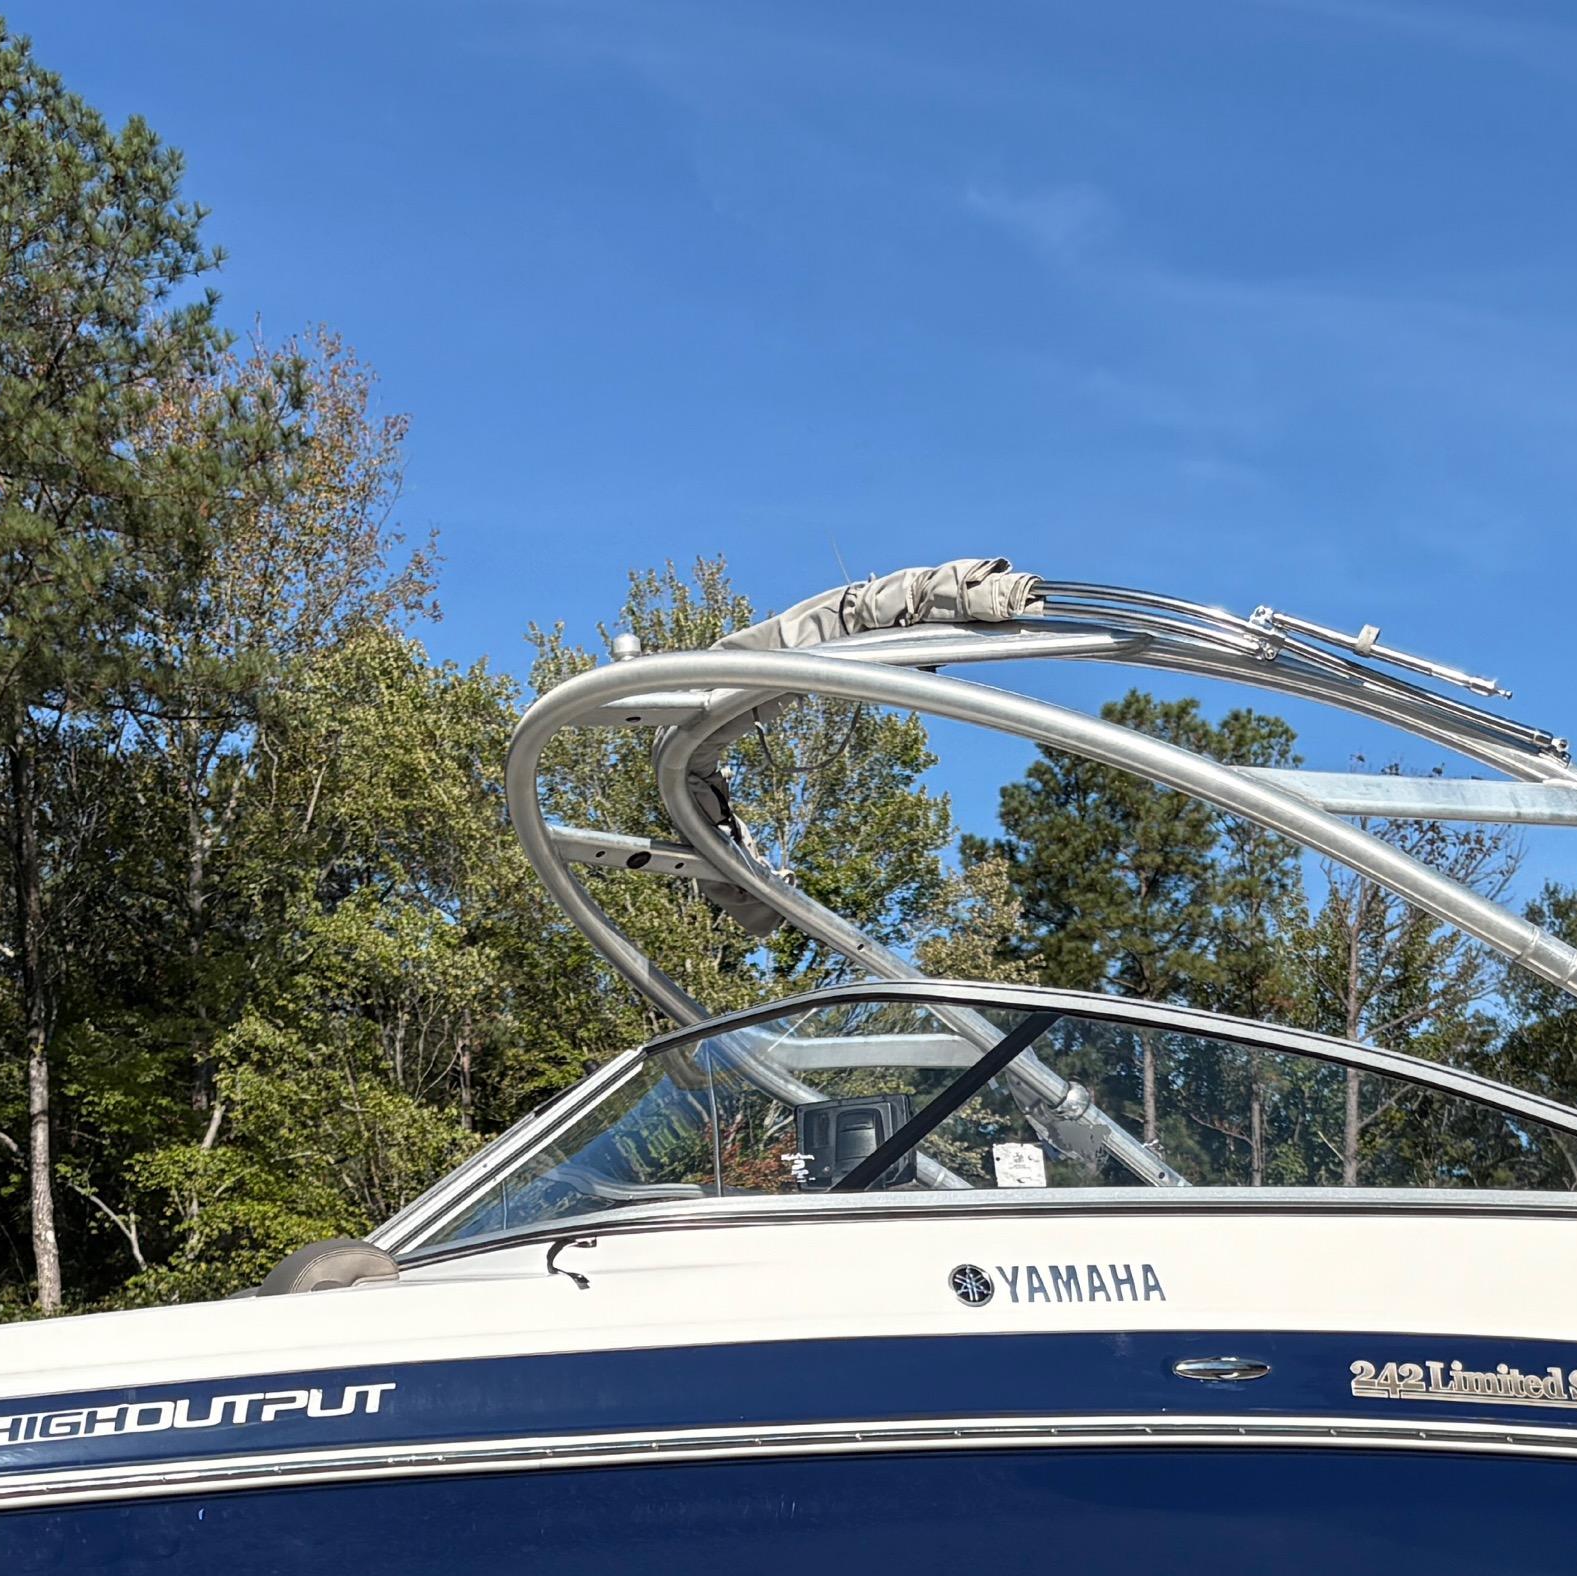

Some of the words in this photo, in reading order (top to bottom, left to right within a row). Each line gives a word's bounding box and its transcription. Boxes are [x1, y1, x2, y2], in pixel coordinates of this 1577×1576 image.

[995, 1263, 1166, 1303] YAMAHA
[1349, 1360, 1425, 1398] 242
[1425, 1359, 1567, 1400] Limited
